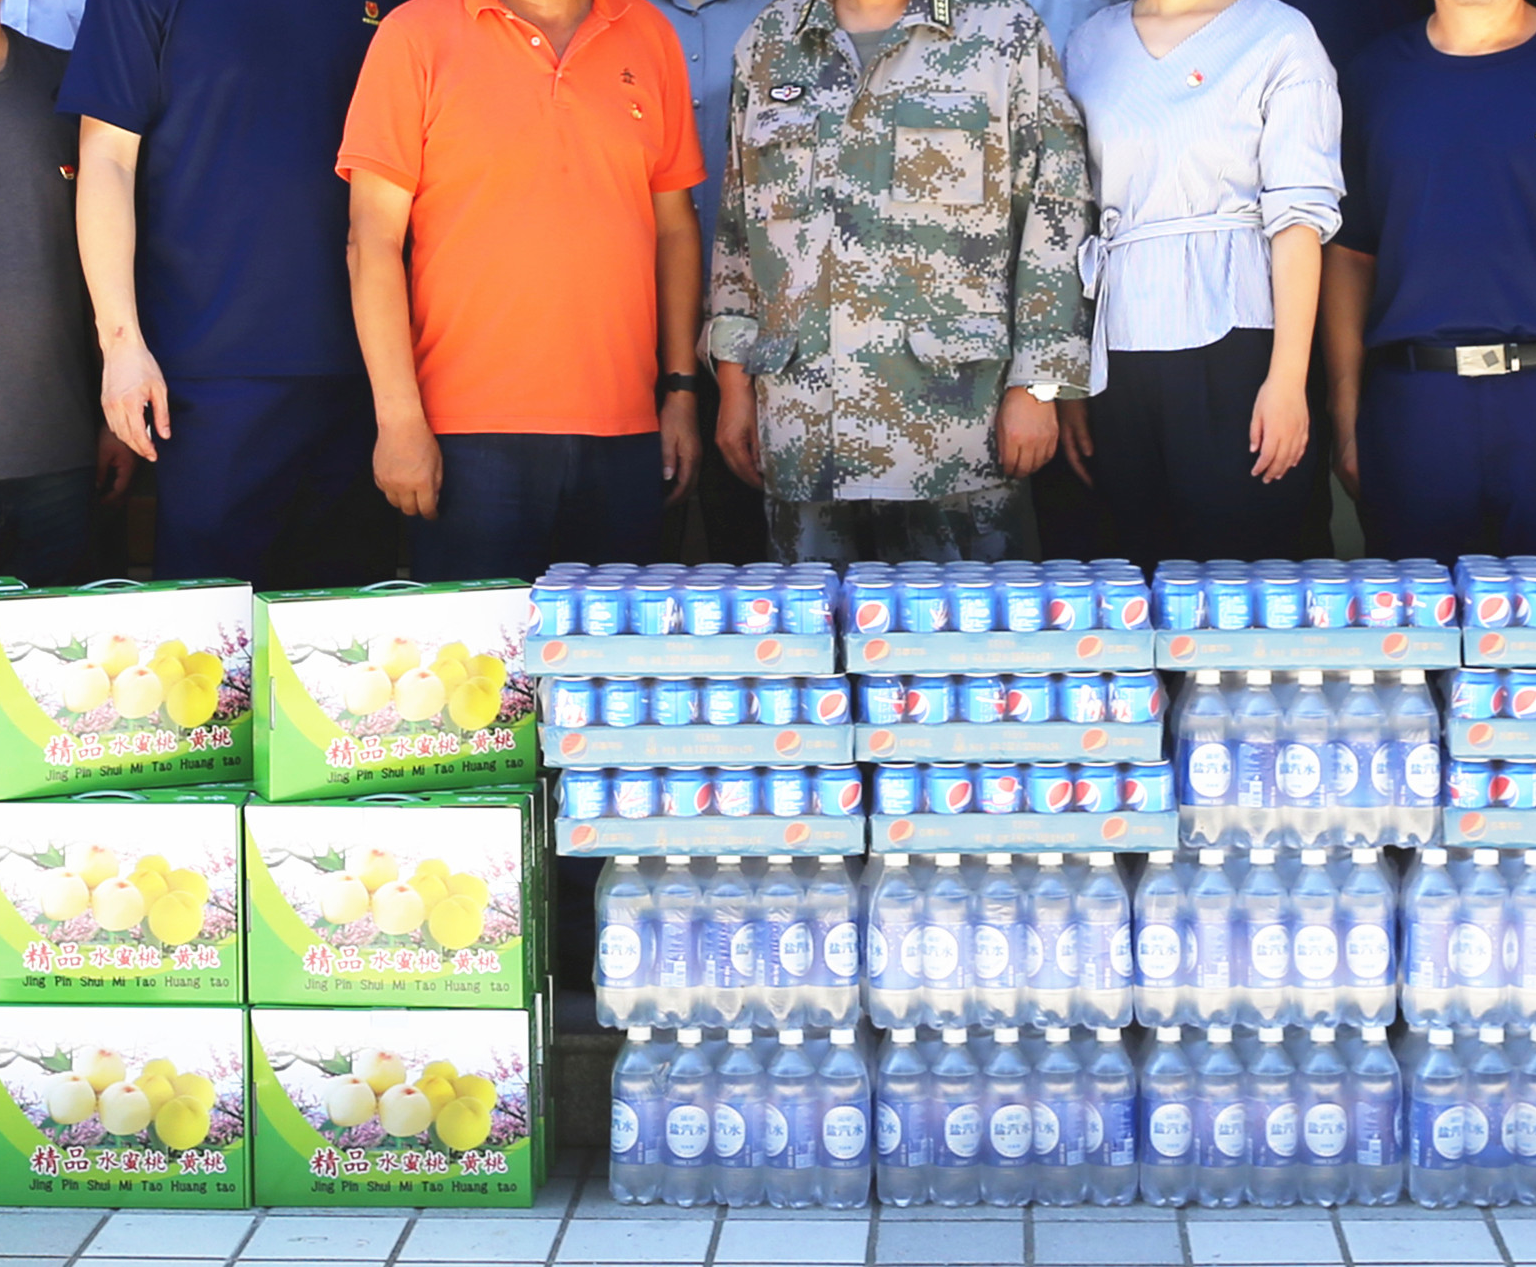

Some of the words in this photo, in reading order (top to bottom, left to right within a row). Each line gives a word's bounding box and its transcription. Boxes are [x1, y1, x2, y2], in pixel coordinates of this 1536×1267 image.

[46, 735, 102, 764] 精品
[111, 730, 177, 754] 水蜜桃
[188, 727, 232, 750] 黄桃
[327, 738, 383, 766] 精品
[392, 734, 459, 756] 水蜜桃
[471, 729, 514, 751] 黄桃
[46, 769, 68, 781] Jing
[75, 767, 91, 777] Pin
[100, 765, 121, 776] Shui
[131, 763, 143, 773] Mi
[152, 761, 172, 771] Tao
[181, 758, 213, 770] Huang
[223, 756, 241, 766] tao
[327, 772, 350, 783] Jing
[357, 770, 373, 780] Pin
[382, 768, 404, 778] Shui
[412, 766, 424, 776] Mi
[434, 763, 454, 774] Tao
[462, 760, 496, 772] Huang
[505, 758, 523, 768] tao
[25, 943, 82, 970] 精品
[91, 947, 160, 966] 水蜜桃
[172, 947, 219, 968] 黄桃
[305, 948, 362, 973] 精品
[371, 951, 440, 970] 水蜜桃
[452, 952, 499, 971] 黄桃
[22, 976, 46, 988] Jing
[55, 976, 71, 986] Pin
[80, 977, 104, 987] Shui
[112, 977, 125, 986] Mi
[134, 978, 156, 986] Tao
[165, 977, 200, 988] Huang
[210, 978, 229, 987] tao
[304, 980, 328, 991] Jing
[335, 980, 352, 989] Pin
[361, 980, 384, 990] Shui
[392, 981, 405, 990] Mi
[415, 981, 436, 990] Tao
[445, 981, 481, 992] Huang
[491, 982, 509, 991] tao
[32, 1147, 88, 1174] 精品
[98, 1151, 167, 1171] 水蜜桃
[179, 1151, 225, 1173] 黄桃
[312, 1148, 368, 1176] 精品
[379, 1153, 447, 1172] 水蜜桃
[460, 1153, 506, 1173] 黄桃
[29, 1179, 53, 1191] Jing
[62, 1180, 78, 1190] Pin
[87, 1181, 110, 1190] Shui
[119, 1181, 132, 1191] Mi
[142, 1181, 163, 1191] Tao
[171, 1181, 206, 1193] Huang
[216, 1182, 235, 1192] tao
[311, 1181, 334, 1193] Jing
[342, 1181, 358, 1191] Pin
[367, 1181, 390, 1191] Shui
[400, 1182, 412, 1191] Mi
[422, 1182, 444, 1191] Tao
[452, 1182, 487, 1193] Huang
[498, 1183, 517, 1191] tao
